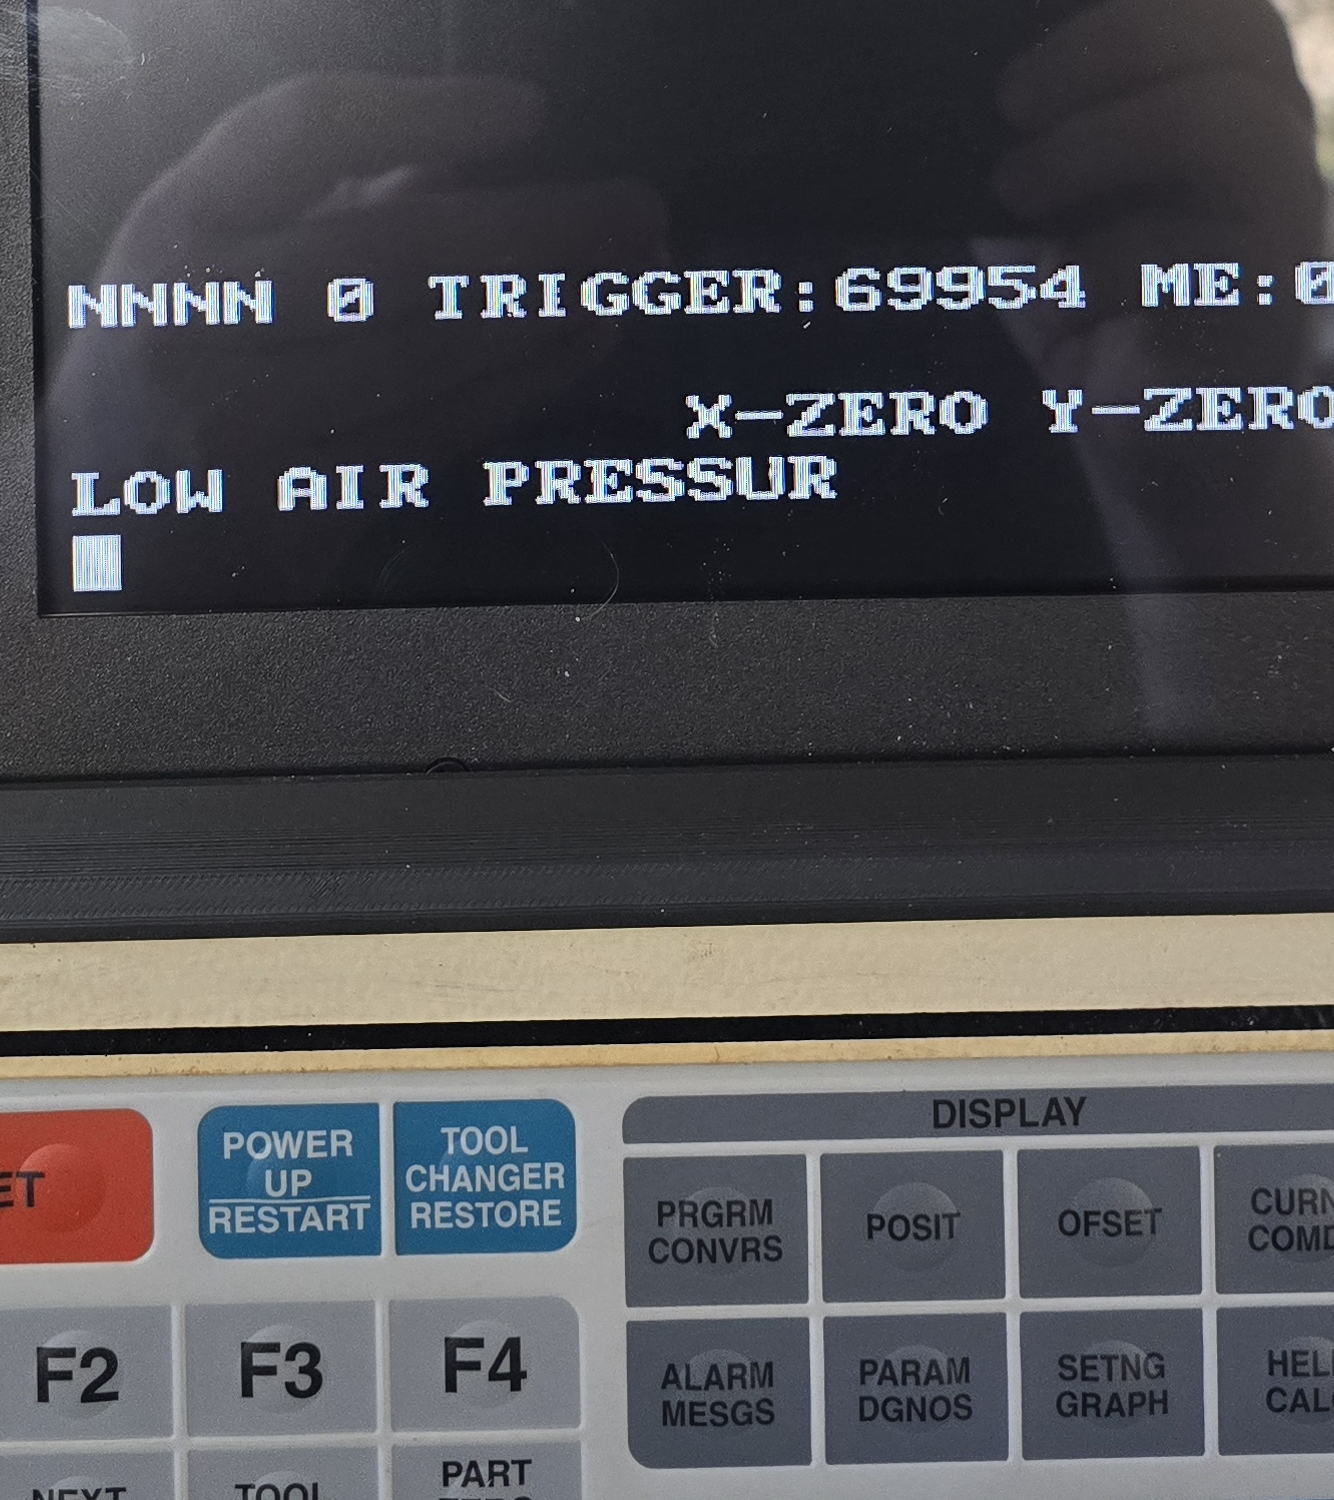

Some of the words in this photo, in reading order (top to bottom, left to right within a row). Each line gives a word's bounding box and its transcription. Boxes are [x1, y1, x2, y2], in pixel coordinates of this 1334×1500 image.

[68, 280, 272, 328] NNNN
[326, 278, 373, 322] 0
[427, 264, 1085, 323] TRIGGER:69954
[685, 389, 988, 438] X-ZERO
[71, 468, 224, 518] LOW
[276, 462, 429, 513] AIR
[483, 454, 838, 508] PRESSUR
[932, 1097, 1087, 1131] DISPLAY
[223, 1129, 354, 1160] POWER
[441, 1125, 528, 1155] TOOL
[265, 1168, 313, 1197] UP
[405, 1163, 566, 1195] CHANGER
[209, 1203, 371, 1235] RESTART
[410, 1198, 562, 1229] RESTORE
[656, 1198, 773, 1229] PRGRM
[867, 1211, 960, 1242] POSIT
[1058, 1207, 1162, 1238] OFSET
[647, 1234, 783, 1265] CONVRS
[35, 1347, 120, 1405] F2
[240, 1341, 324, 1400] F3
[444, 1336, 528, 1394] F4
[661, 1361, 774, 1391] ALARM
[859, 1357, 970, 1388] PARAM
[1057, 1353, 1166, 1384] SETNG
[661, 1398, 776, 1429] MESGS
[857, 1393, 973, 1424] DGNOS
[1055, 1389, 1169, 1420] GRAPH
[442, 1459, 532, 1487] PART
